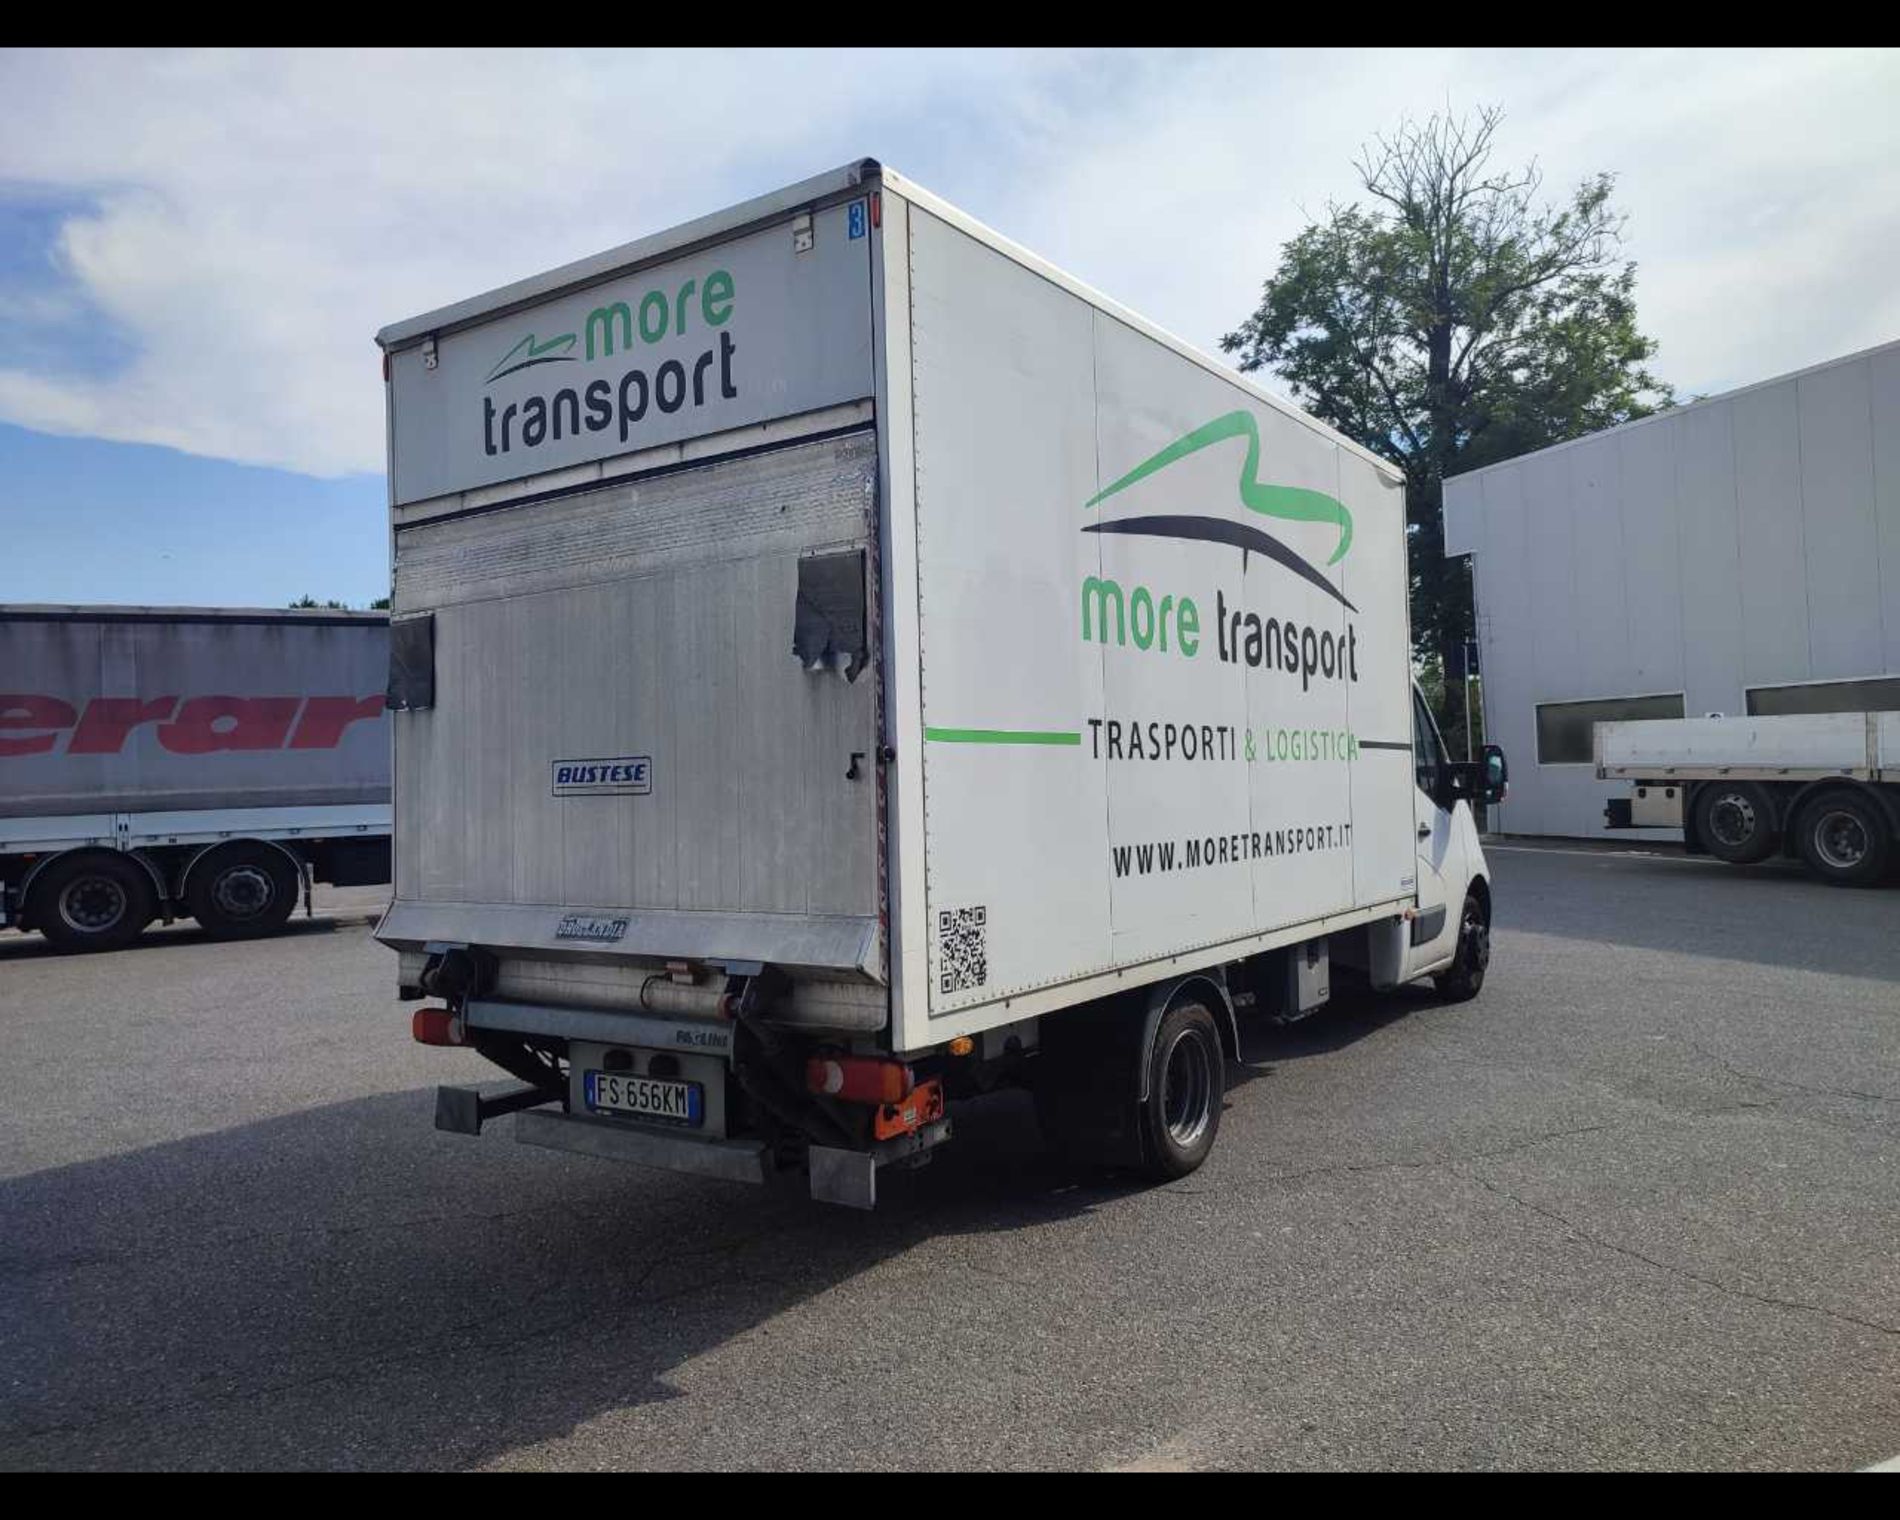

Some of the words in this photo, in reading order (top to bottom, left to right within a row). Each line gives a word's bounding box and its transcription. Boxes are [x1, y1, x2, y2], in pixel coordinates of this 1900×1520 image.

[850, 203, 862, 237] 3
[585, 270, 736, 361] more
[483, 331, 738, 457] transport
[1081, 576, 1200, 658] more
[1217, 589, 1358, 692] transport
[1088, 718, 1236, 761] TRASPORTI
[1243, 730, 1256, 761] &
[1266, 729, 1359, 761] LOGISTICA
[557, 763, 647, 784] BUSTESE
[1113, 823, 1352, 878] WWW.MORETRANSPORT.IT
